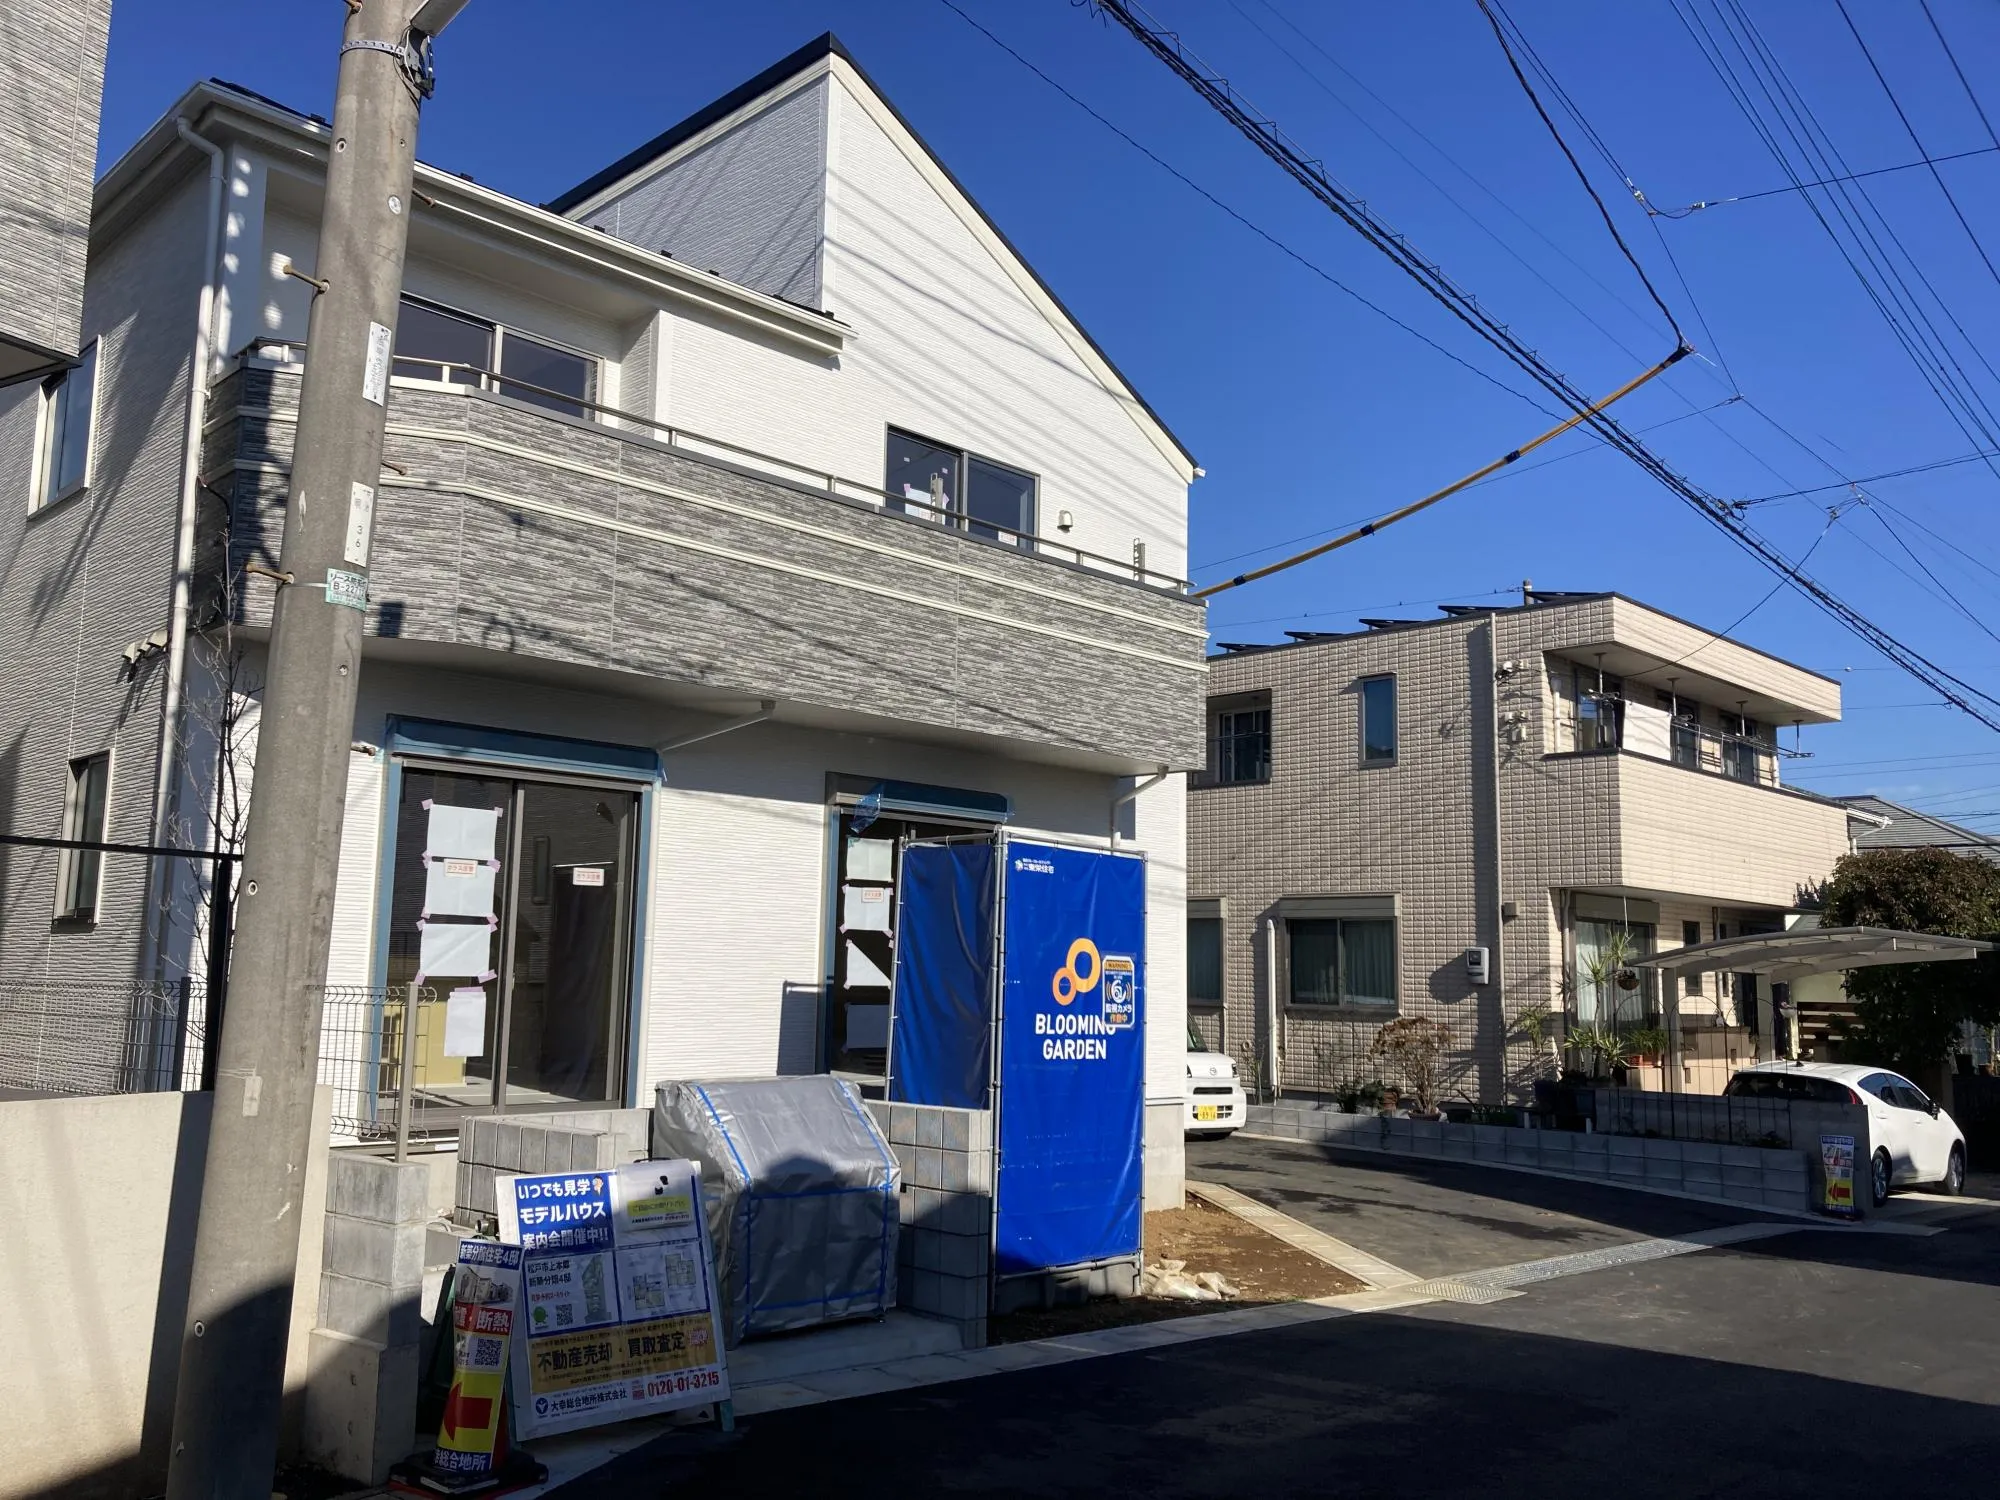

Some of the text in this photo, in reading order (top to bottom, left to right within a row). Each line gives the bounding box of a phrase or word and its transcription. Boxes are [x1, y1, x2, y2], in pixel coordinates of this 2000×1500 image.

[1042, 1039, 1107, 1060] GARDEN
[518, 1178, 591, 1200] いつでも見学
[520, 1201, 607, 1225] モデルハウス
[647, 1371, 720, 1398] 0120-01-3215
